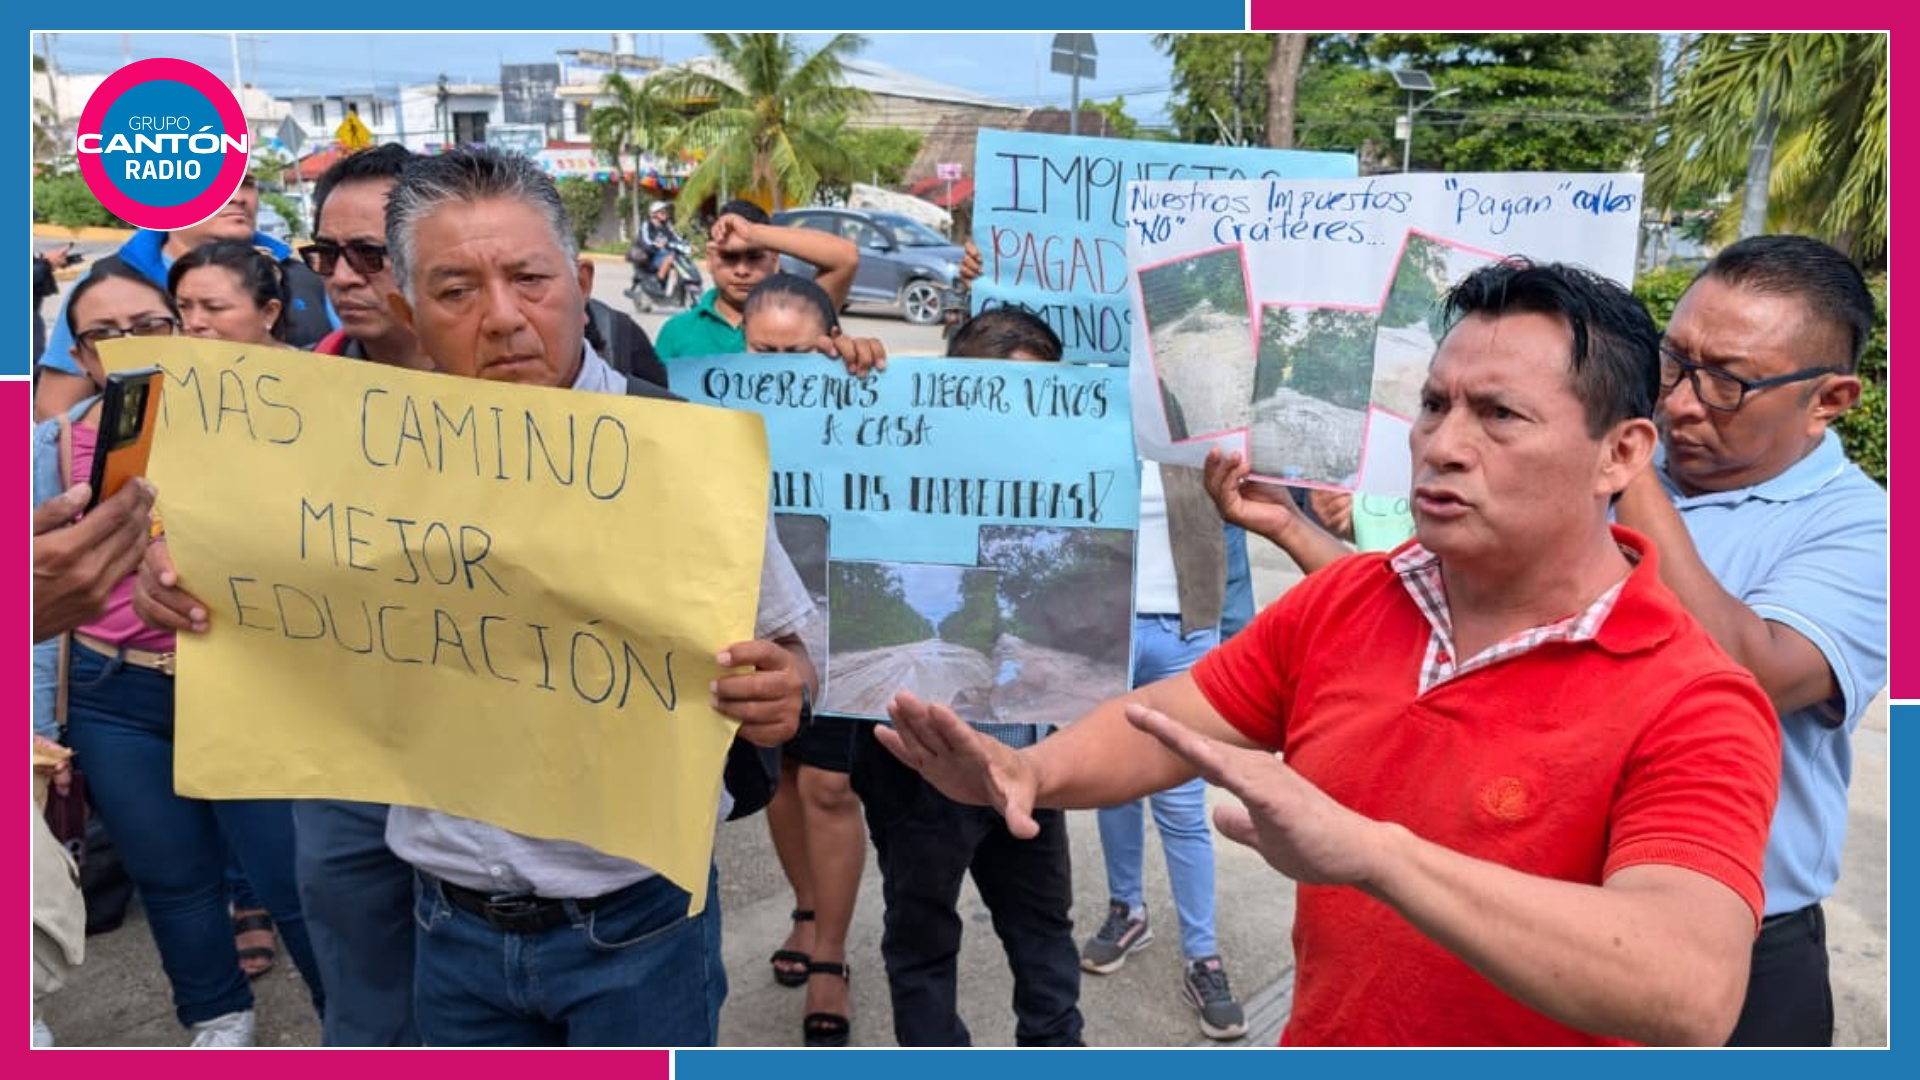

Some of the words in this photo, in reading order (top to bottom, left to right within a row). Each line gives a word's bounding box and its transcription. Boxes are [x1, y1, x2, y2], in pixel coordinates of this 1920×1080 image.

[1132, 180, 1251, 213] Nuestros
[1267, 180, 1412, 219] Impuestos
[704, 367, 879, 409] QUEREMOS
[154, 355, 303, 444] MÁS
[362, 388, 630, 500] CAMINO
[822, 413, 844, 446] A
[856, 413, 933, 447] CASA
[300, 498, 508, 595] MEJOR
[229, 576, 678, 711] EDUCACIÓN
